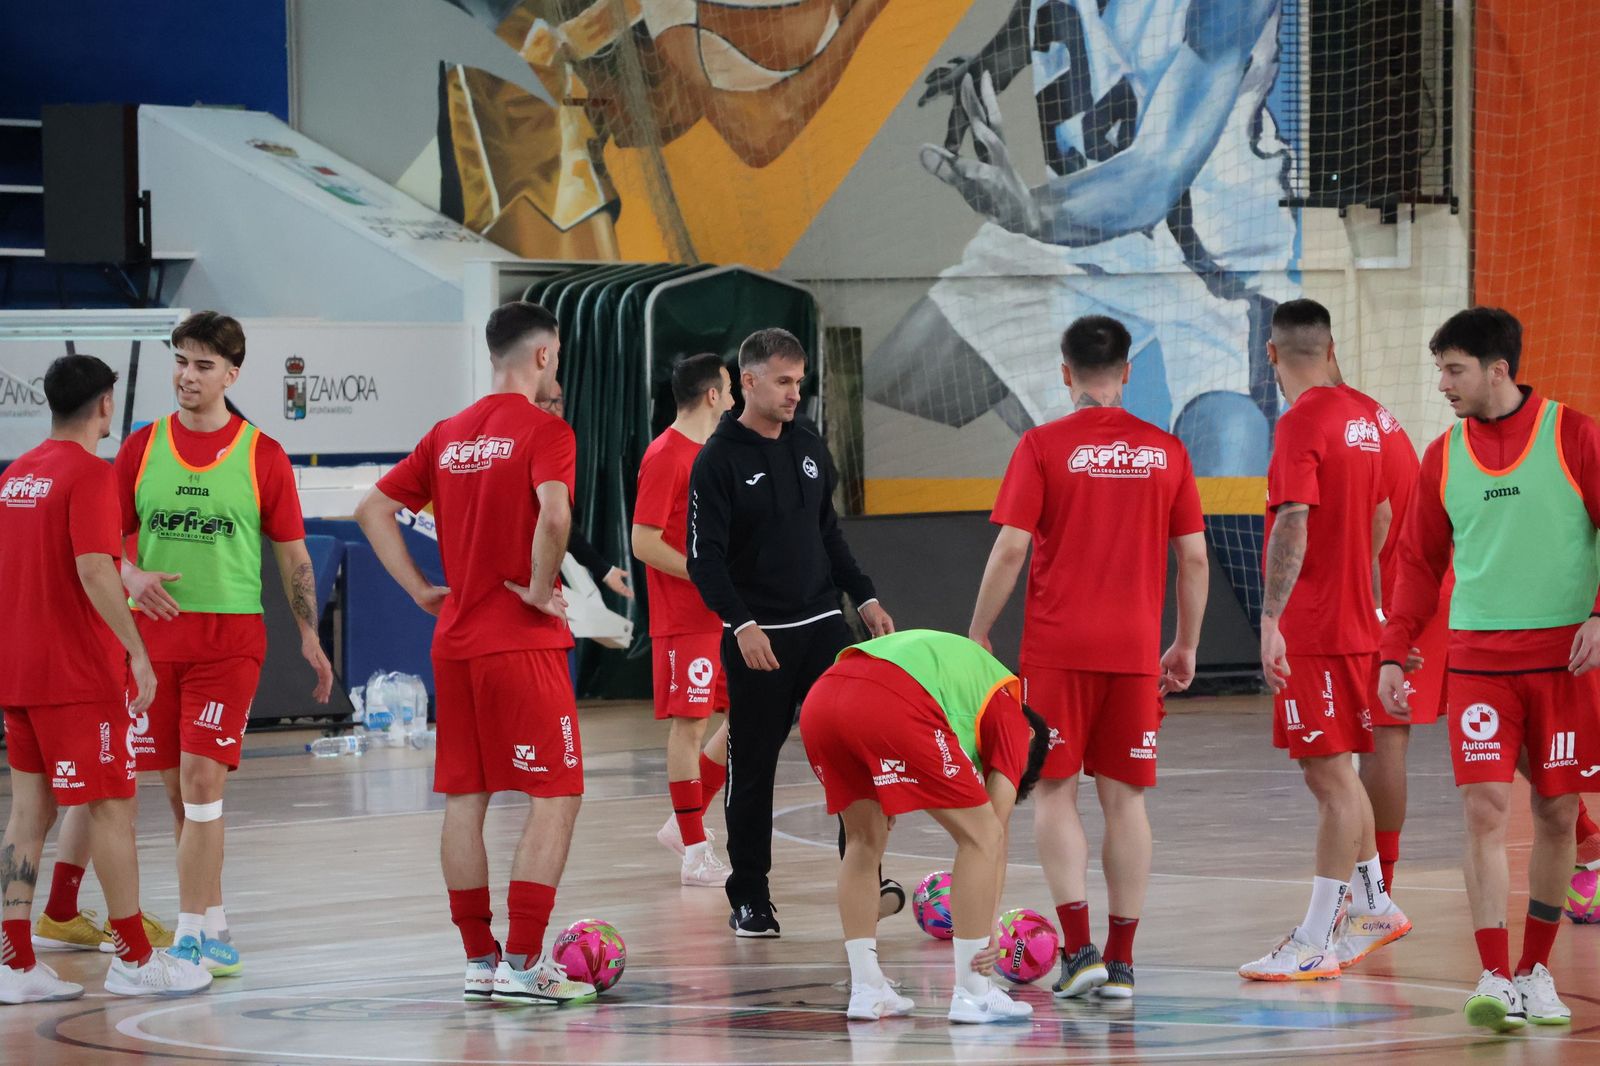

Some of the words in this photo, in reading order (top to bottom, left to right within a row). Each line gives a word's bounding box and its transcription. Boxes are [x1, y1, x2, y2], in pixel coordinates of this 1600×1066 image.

[309, 375, 379, 402] ZAMORA
[1483, 486, 1520, 501] Joma
[1461, 741, 1501, 751] Autoram
[1464, 752, 1501, 762] Zamora
[1543, 759, 1579, 769] CASASECA
[1013, 939, 1025, 969] Joma
